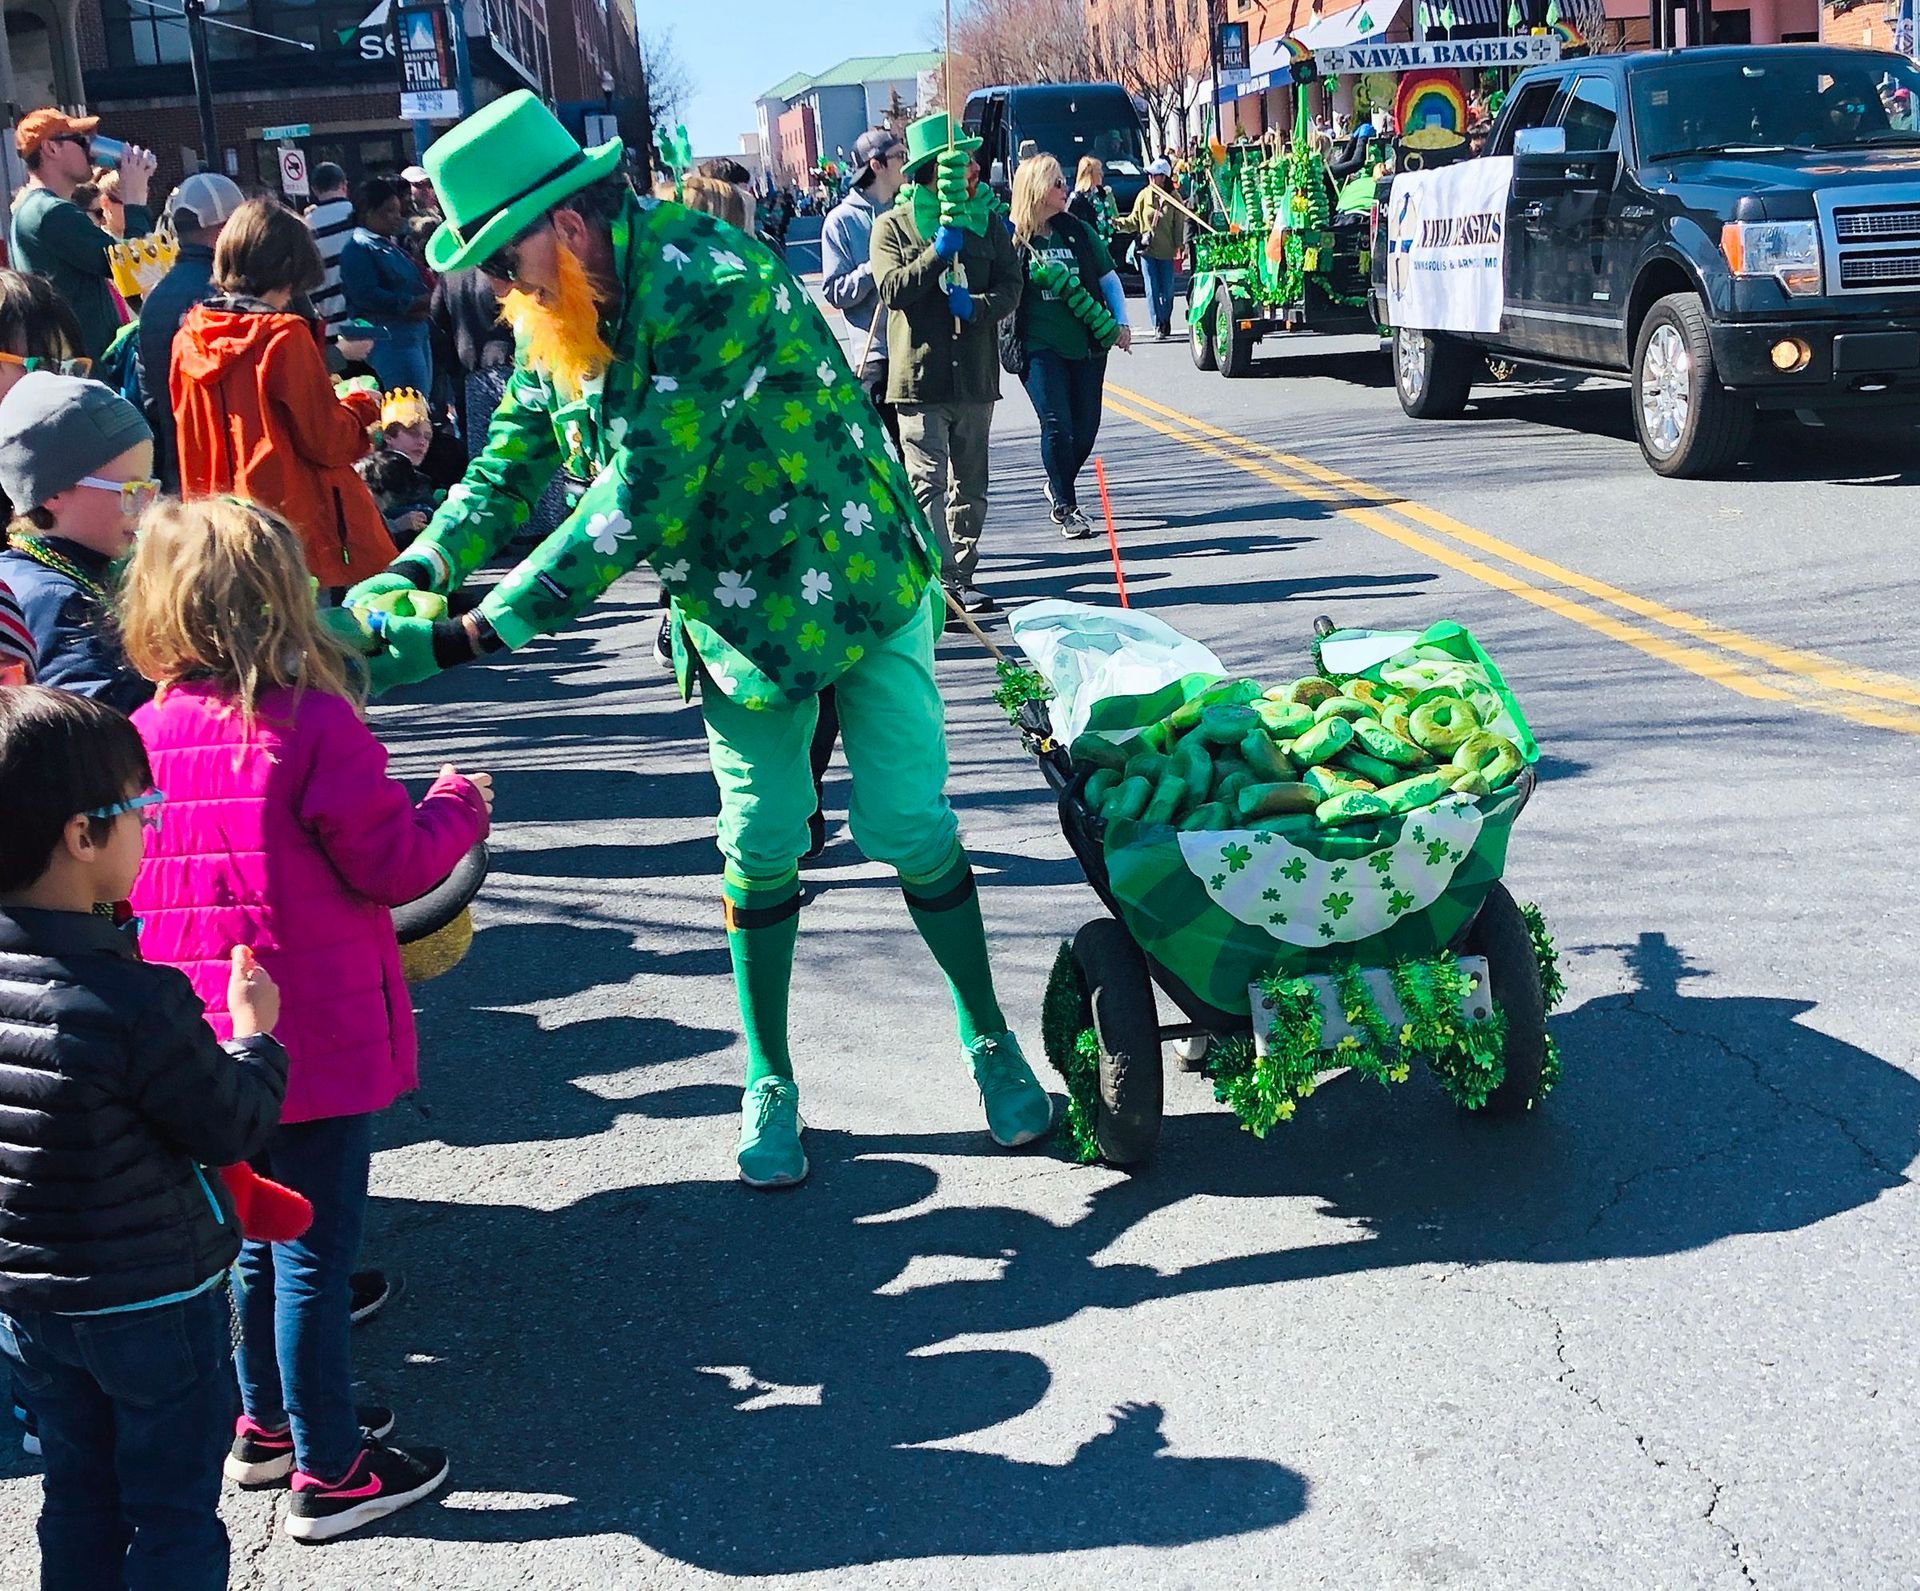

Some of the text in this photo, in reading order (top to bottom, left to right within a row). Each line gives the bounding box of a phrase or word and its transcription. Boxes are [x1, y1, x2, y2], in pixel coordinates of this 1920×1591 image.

[1349, 40, 1529, 69] NAVAL BAGELS
[404, 61, 440, 81] FILM
[1484, 257, 1498, 268] MD
